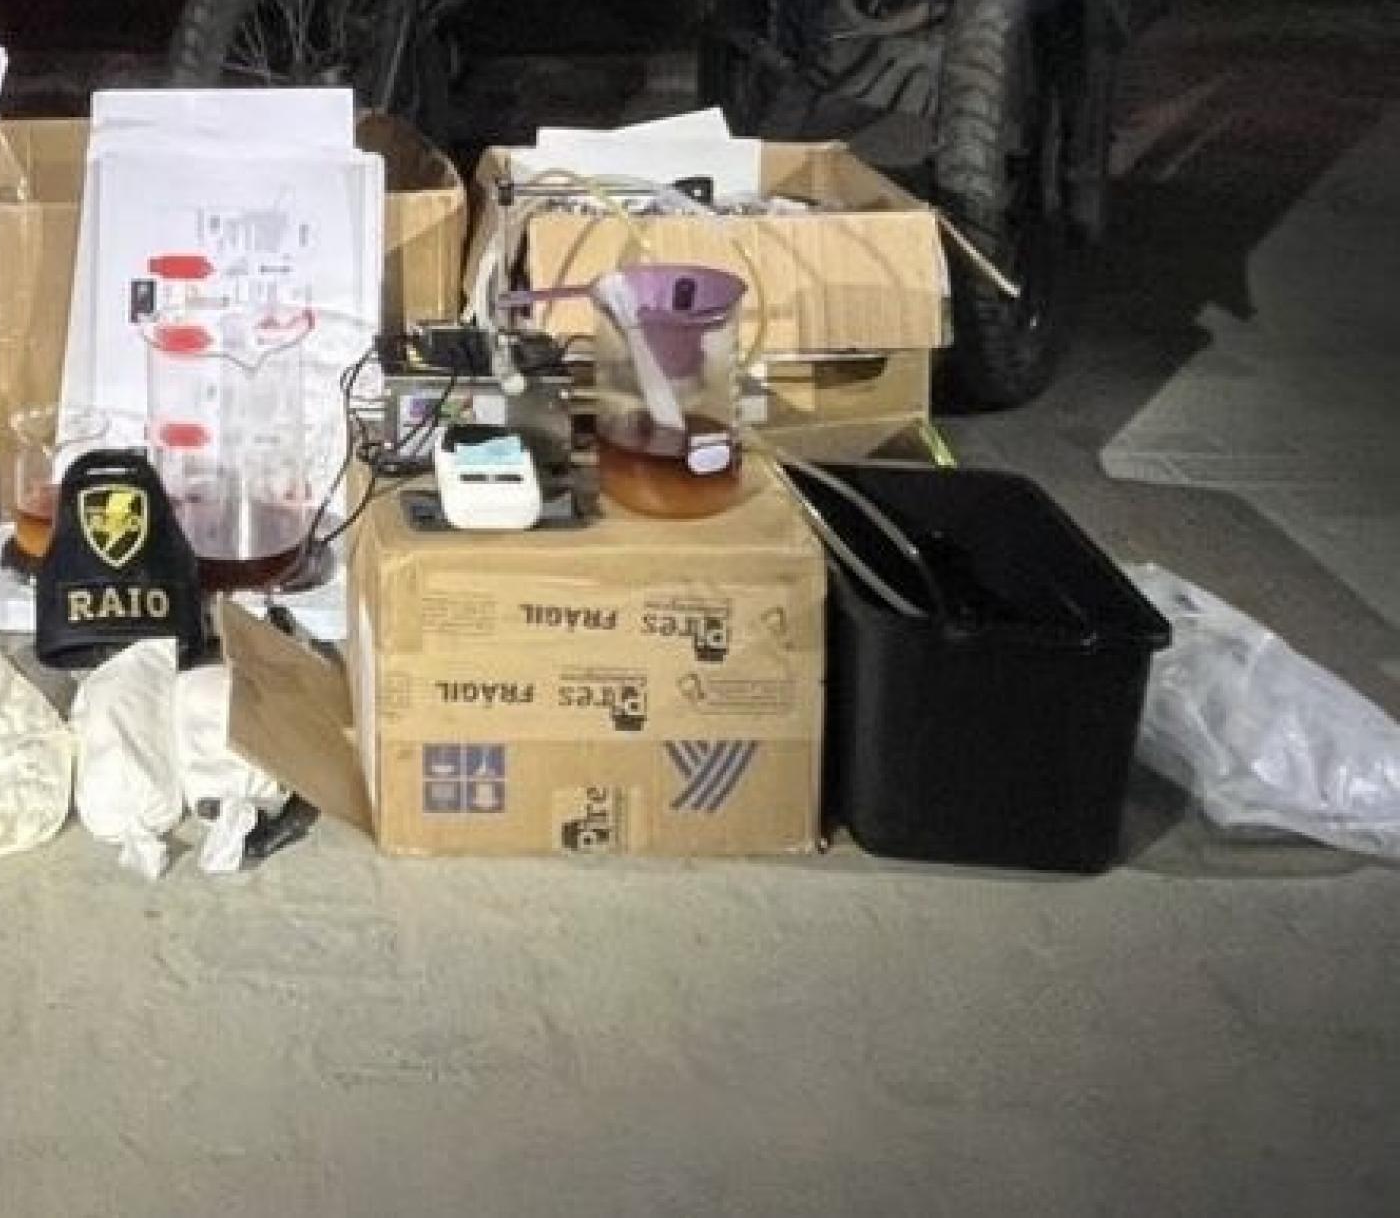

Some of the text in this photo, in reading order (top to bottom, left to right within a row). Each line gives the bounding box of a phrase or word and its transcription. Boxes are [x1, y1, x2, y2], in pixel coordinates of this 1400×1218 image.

[67, 587, 170, 622] RAIO
[519, 603, 617, 633] FRÁGIL
[434, 679, 535, 709] FRÁGIL
